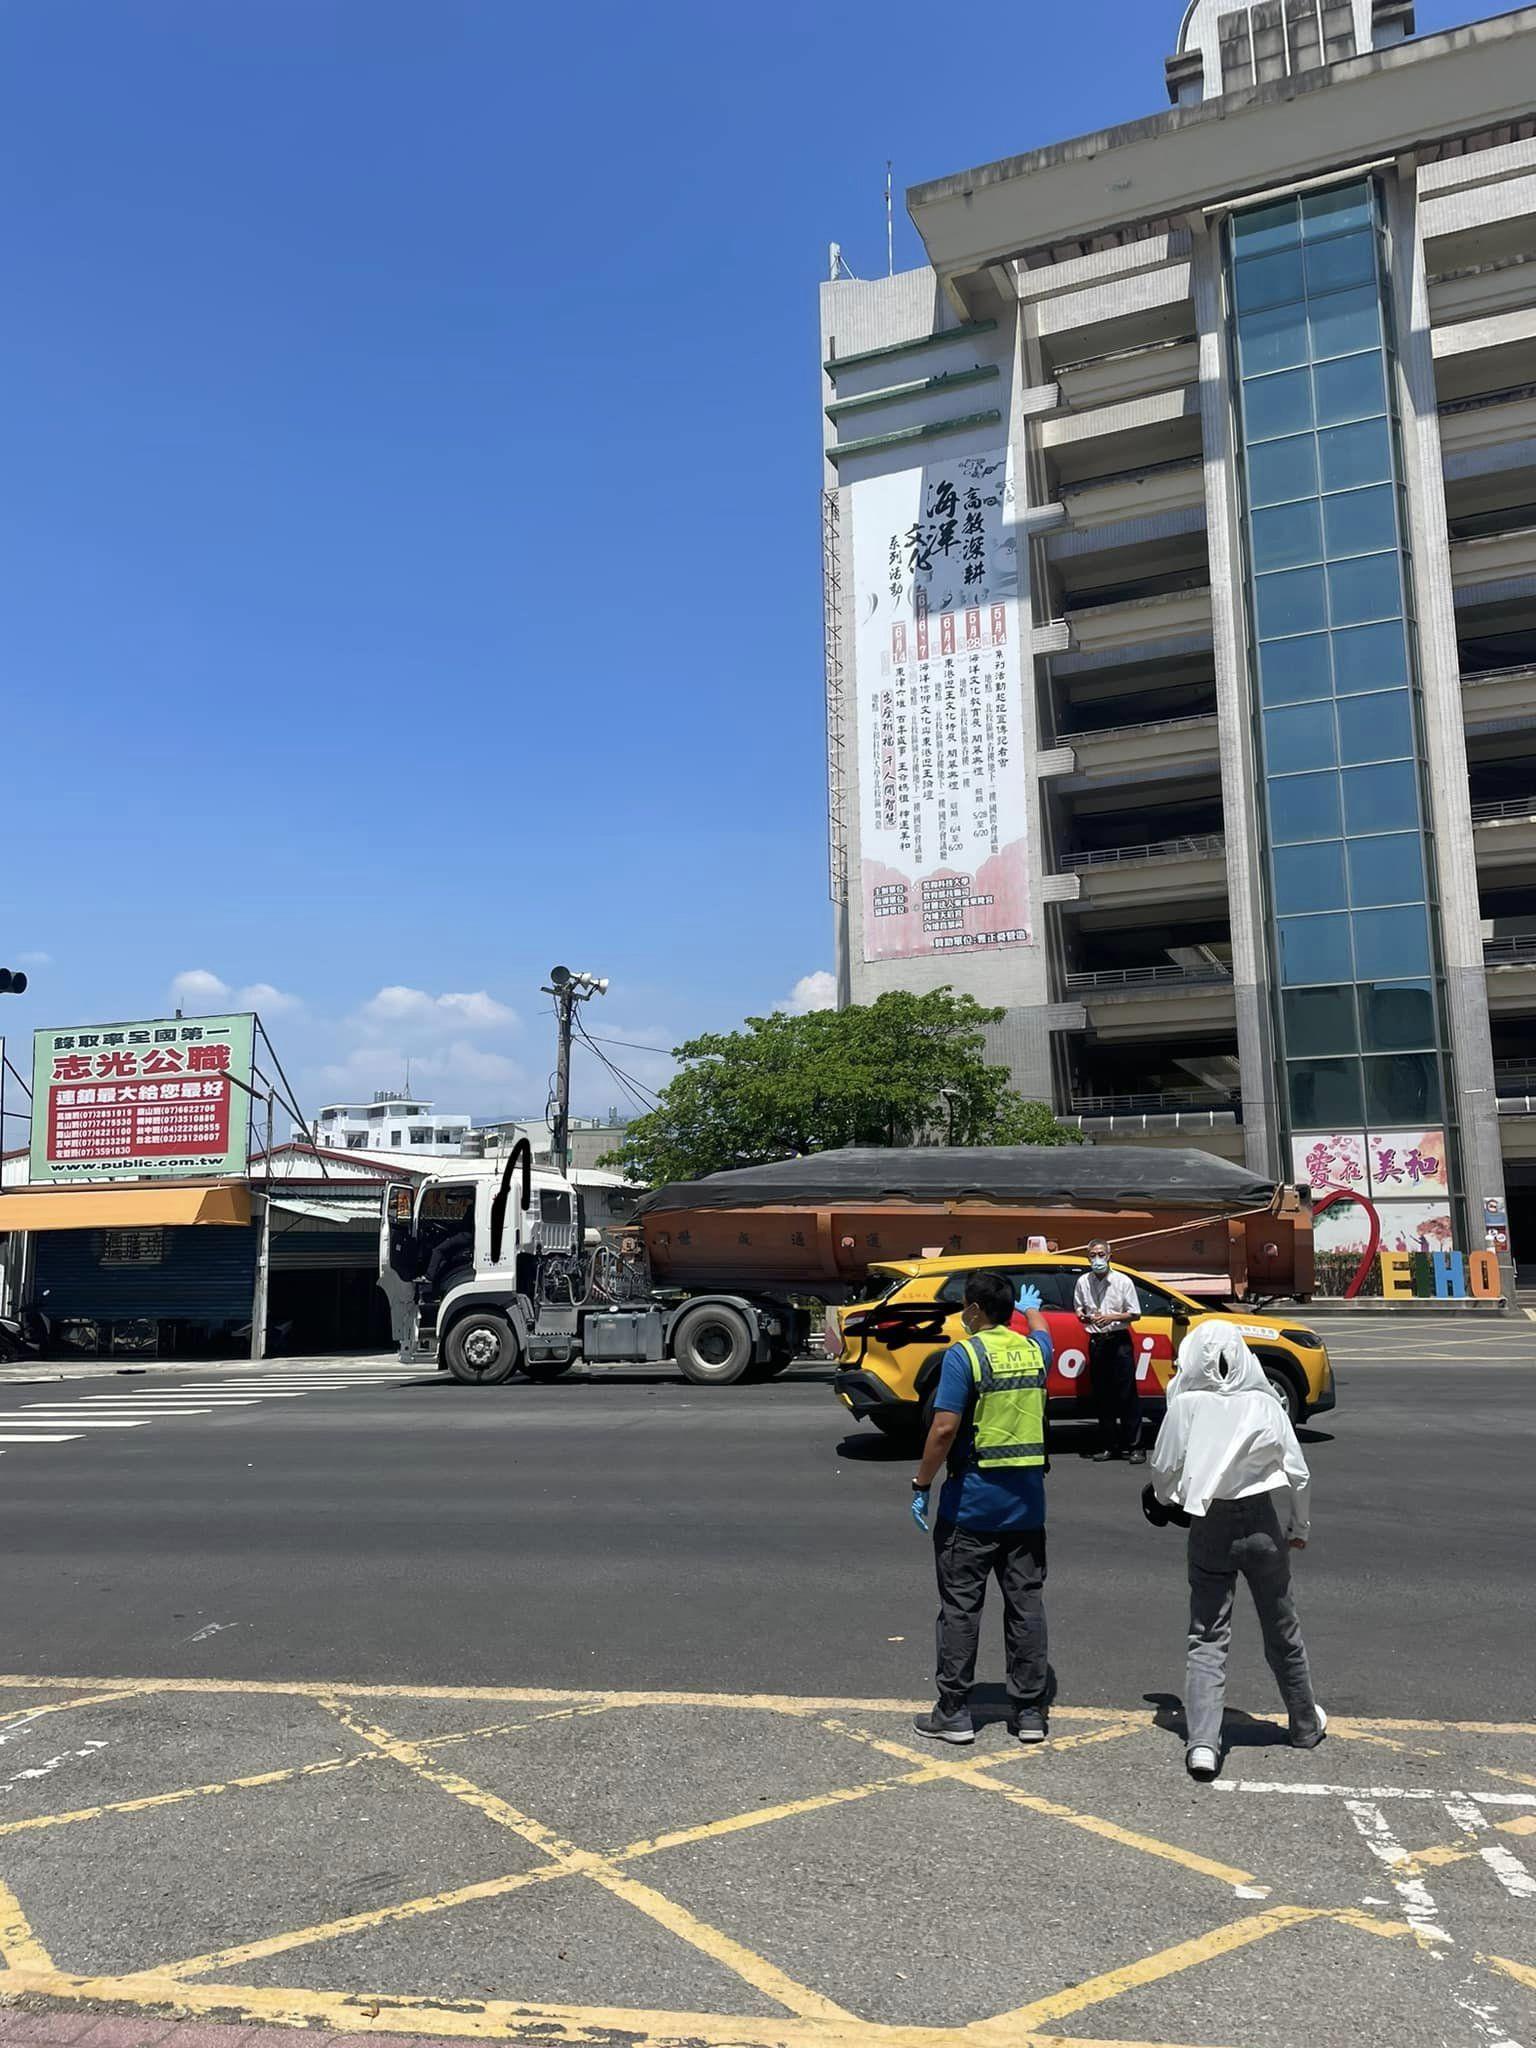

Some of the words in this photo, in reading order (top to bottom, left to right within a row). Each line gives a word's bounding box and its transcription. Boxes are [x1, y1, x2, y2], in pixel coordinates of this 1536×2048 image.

[926, 480, 961, 557] 海洋
[961, 487, 985, 585] 高教深耕
[889, 534, 903, 598] 系列活動
[942, 617, 956, 654] 6月4
[966, 612, 982, 650] 5月28
[990, 607, 1007, 644] 5月14
[893, 628, 906, 663] 6月14
[53, 1026, 230, 1050] 錄取率全國第一
[52, 1044, 232, 1081] 志光公職
[56, 1081, 223, 1106] 連鎖最大給您最好
[51, 1156, 224, 1171] www.public.com.tw
[1306, 1143, 1439, 1191] 愛在美和
[989, 1349, 1038, 1363] EMT
